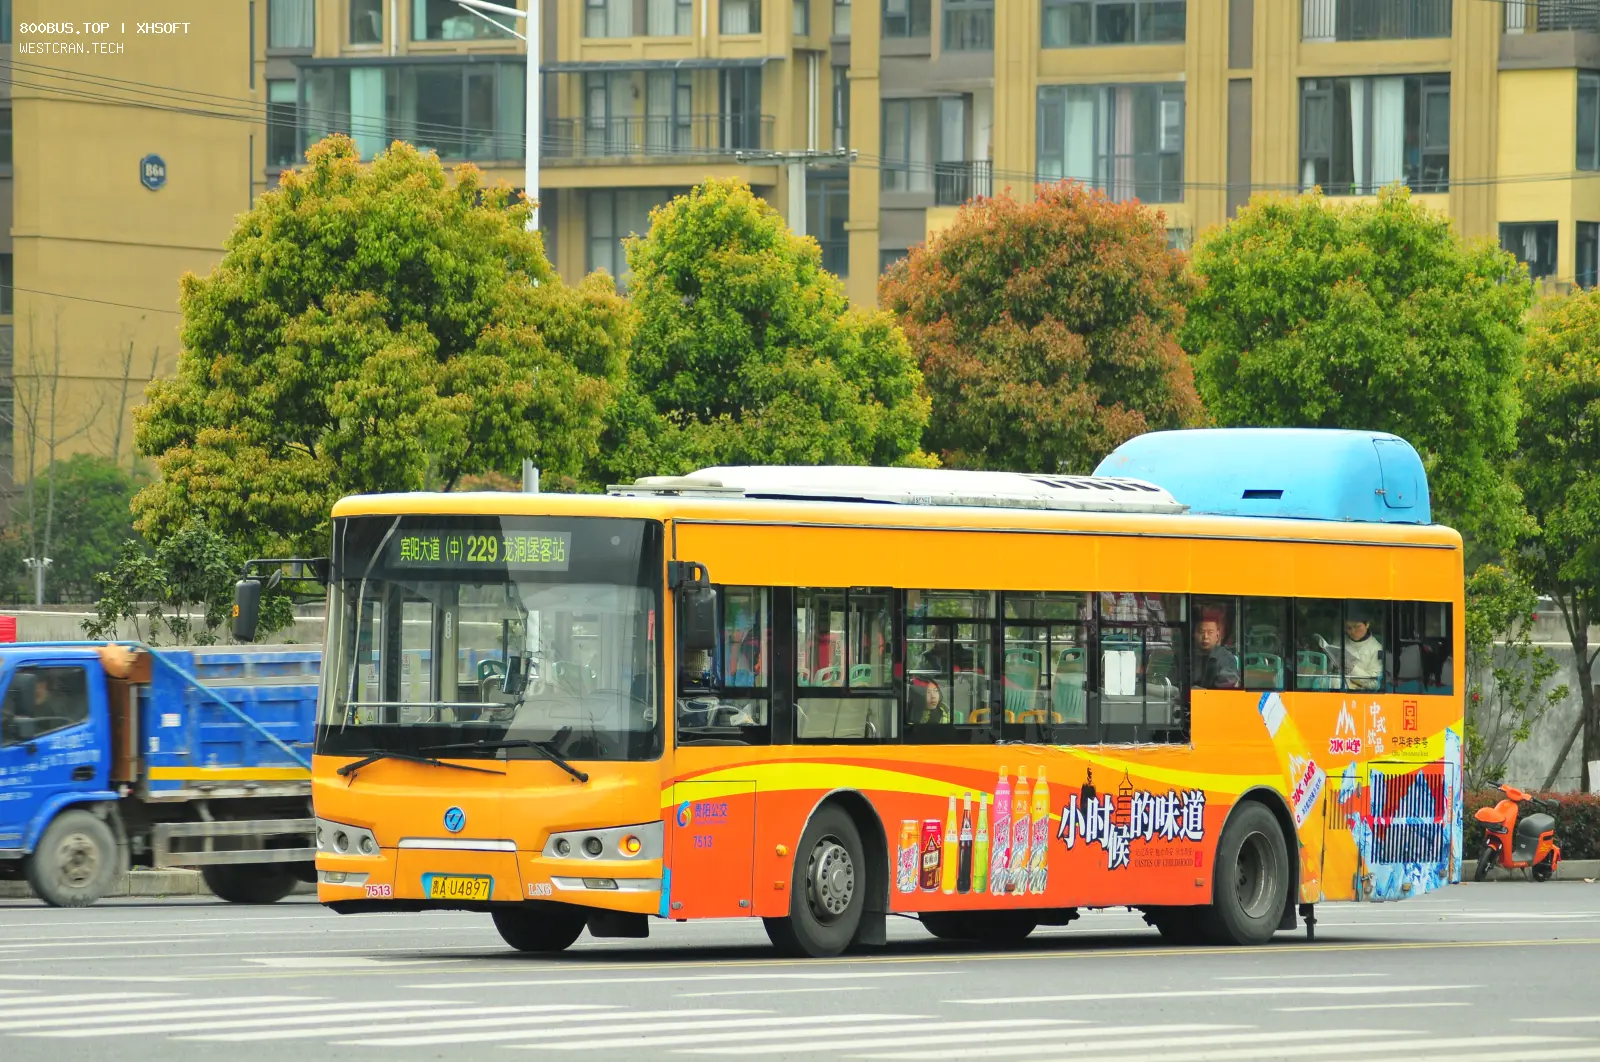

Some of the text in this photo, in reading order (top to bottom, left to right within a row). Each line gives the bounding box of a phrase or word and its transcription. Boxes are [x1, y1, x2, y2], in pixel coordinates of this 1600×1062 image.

[467, 535, 498, 563] 229
[502, 536, 565, 563] 龙洞堡客站
[1329, 737, 1361, 754] 冰峰
[1391, 736, 1428, 749] 中华老字号
[695, 802, 728, 818] 贵阳公交
[693, 835, 713, 849] 7513
[365, 885, 392, 897] 7513
[528, 883, 552, 896] LNG
